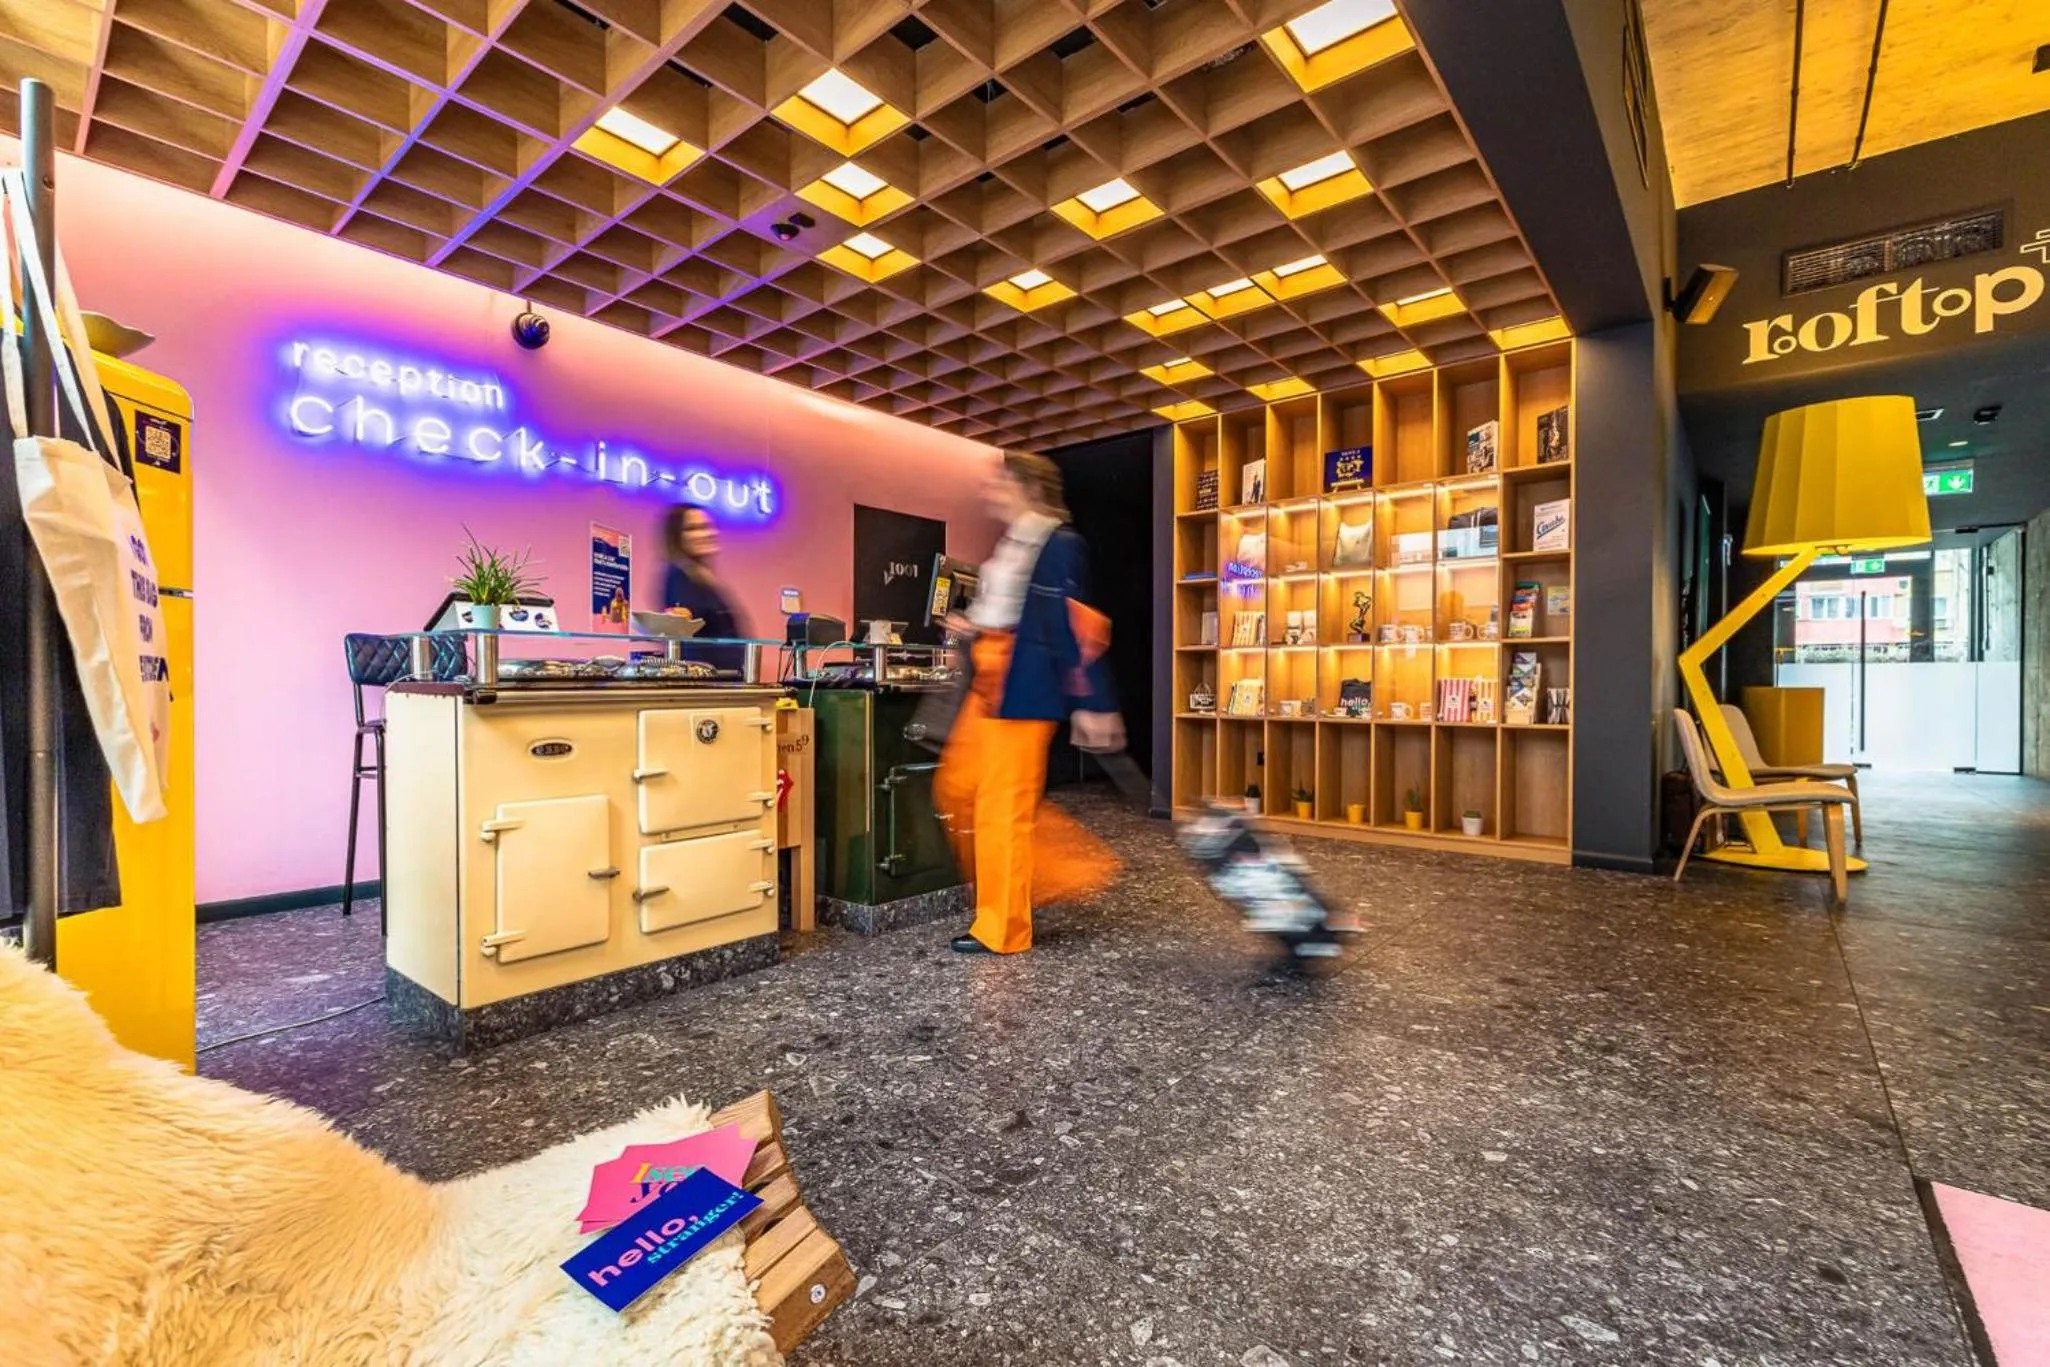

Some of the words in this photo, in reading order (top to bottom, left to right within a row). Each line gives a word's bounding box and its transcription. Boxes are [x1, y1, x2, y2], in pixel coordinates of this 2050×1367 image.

[1742, 265, 2045, 365] rooftop
[293, 342, 504, 410] reception
[291, 394, 772, 513] check-in-out
[588, 1215, 699, 1287] hello,
[647, 1191, 745, 1264] stranger!
